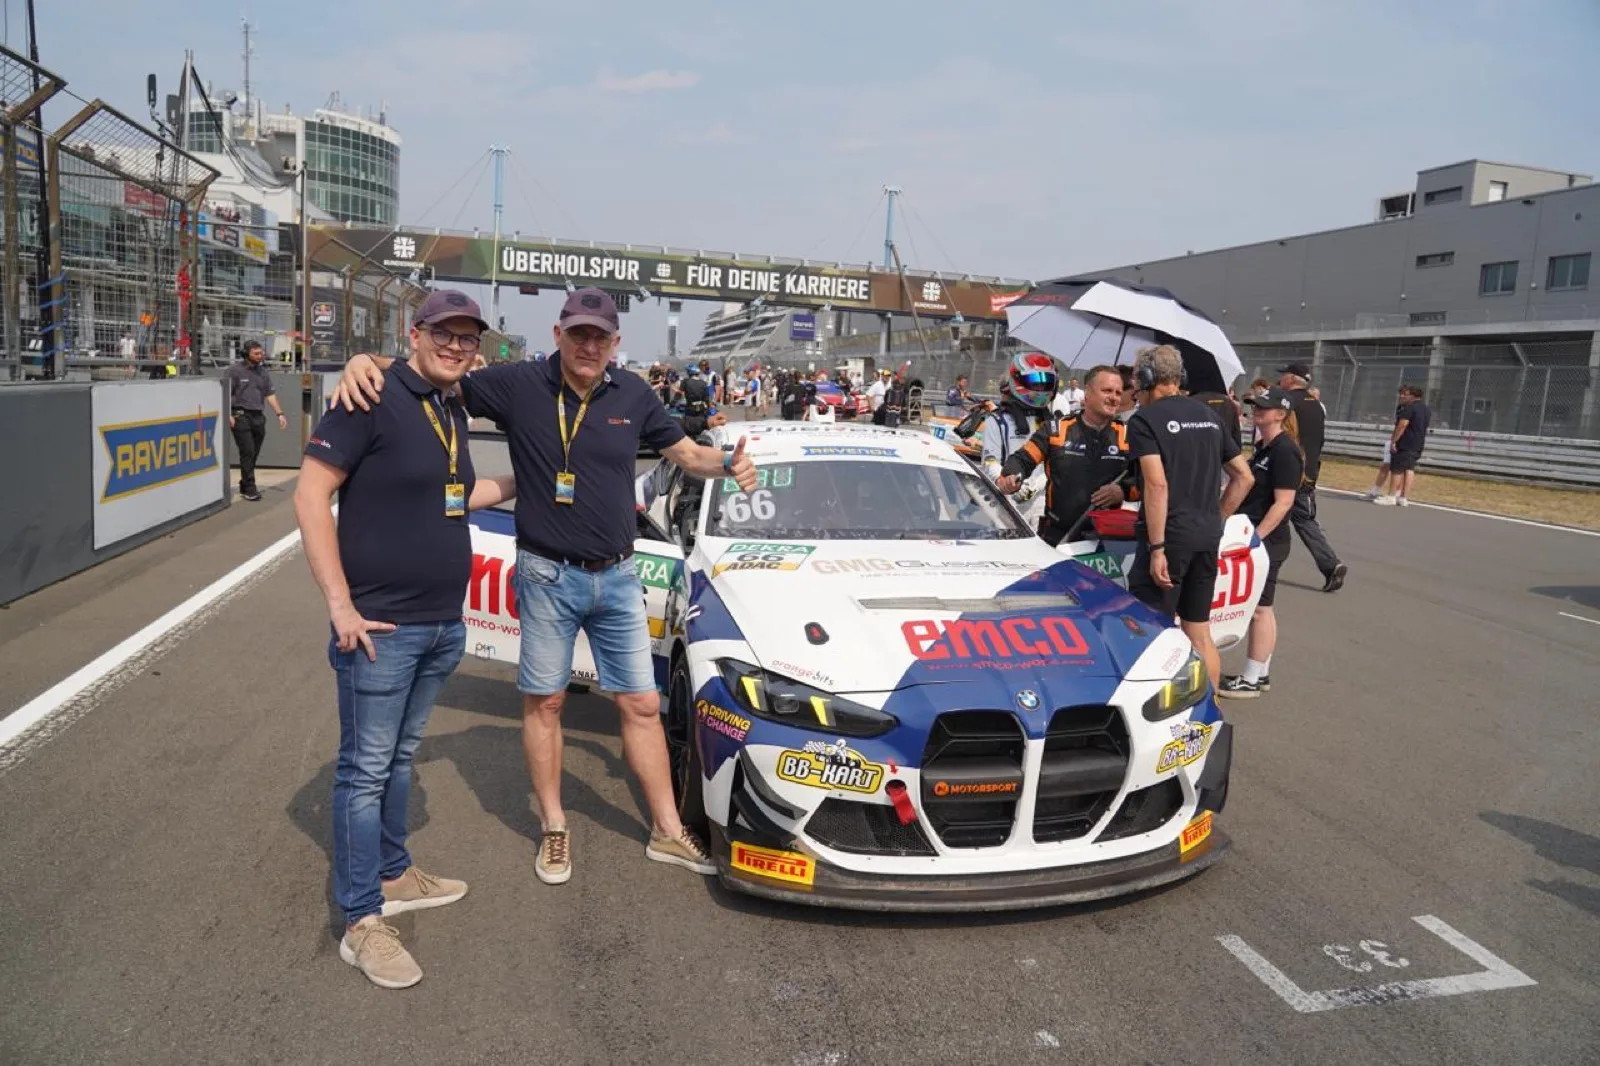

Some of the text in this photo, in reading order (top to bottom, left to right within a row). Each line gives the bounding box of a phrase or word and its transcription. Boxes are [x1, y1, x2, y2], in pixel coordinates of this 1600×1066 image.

[502, 246, 639, 281] ÜBERHOLSPUR
[687, 264, 869, 300] FÜR DEINE KARRIERE
[116, 430, 212, 479] RAVENOL
[809, 447, 893, 458] RAVENOL
[726, 489, 776, 523] 66
[729, 544, 810, 554] DEKRA
[737, 553, 785, 563] 66
[723, 561, 781, 572] ADAC
[811, 558, 895, 575] GMG
[901, 616, 1090, 661] emco
[706, 715, 746, 742] CHANGE
[708, 704, 751, 731] DRIVING
[783, 756, 878, 789] BB-KART
[950, 782, 1017, 794] MOTORSPORT
[736, 846, 807, 878] PIRELLI
